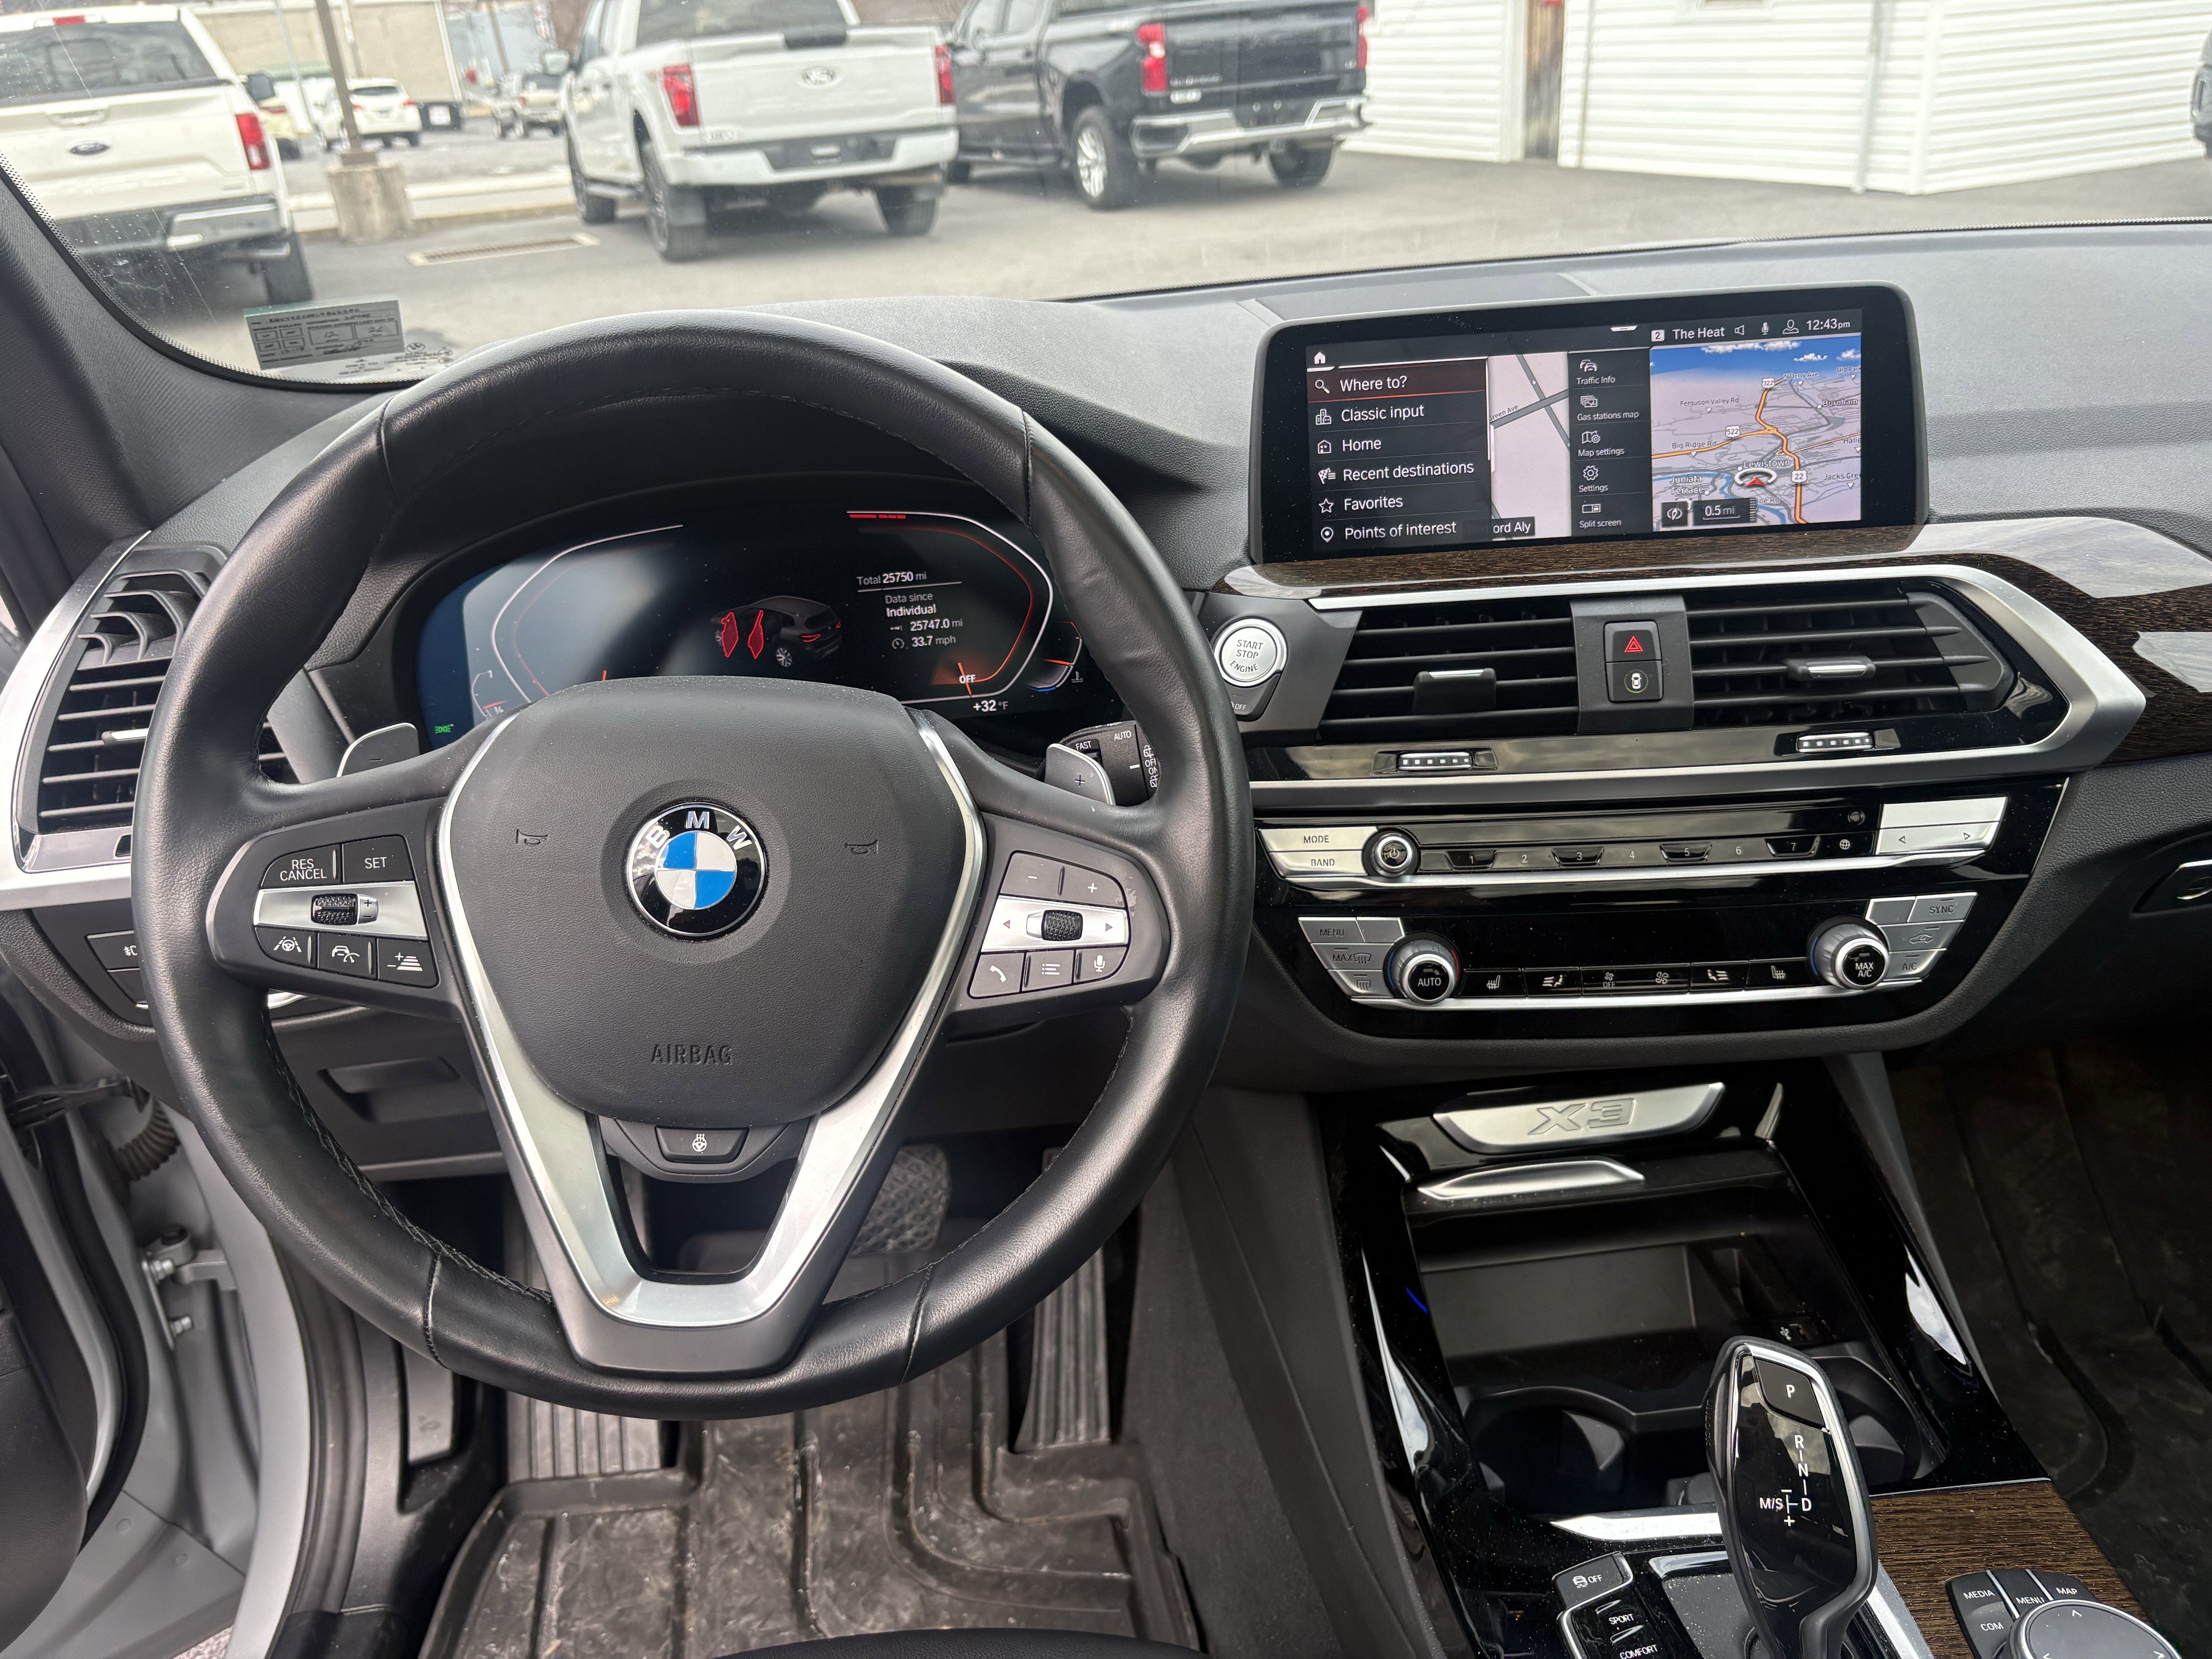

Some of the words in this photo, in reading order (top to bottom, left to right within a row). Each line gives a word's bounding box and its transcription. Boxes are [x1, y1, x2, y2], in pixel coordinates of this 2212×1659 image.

[1806, 318, 1850, 331] 12:43pm
[1673, 328, 1695, 339] The
[1698, 326, 1725, 338] Heat
[1340, 378, 1383, 392] Where
[1386, 376, 1407, 389] to?
[1507, 404, 1518, 413] Ave
[1822, 398, 1858, 407] Burnham
[1341, 407, 1387, 422] Classic
[1391, 405, 1425, 420] input
[1577, 413, 1591, 421] Gas
[1592, 412, 1621, 420] stations
[1342, 438, 1382, 452] Home
[1578, 449, 1594, 457] Map
[1595, 447, 1625, 456] settings
[1743, 459, 1790, 469] Lewistown
[1343, 467, 1389, 481] Recent
[1393, 462, 1474, 479] destinations
[1670, 475, 1702, 484] Juniata
[1578, 484, 1608, 493] Settings
[1670, 486, 1704, 495] Terrace
[1344, 496, 1403, 511] Favorites
[1705, 505, 1721, 516] 0.5
[1723, 506, 1735, 515] mi
[1514, 521, 1531, 534] Aly
[1579, 520, 1596, 528] Split
[1345, 526, 1386, 540] Points
[1389, 524, 1403, 537] of
[1406, 521, 1456, 535] interest
[857, 576, 881, 586] Total
[882, 572, 914, 584] 25750
[915, 571, 927, 581] mi
[884, 594, 907, 604] Data
[908, 592, 933, 602] since
[886, 604, 937, 617] Individual
[910, 619, 950, 631] 25747.0
[951, 618, 963, 628] mi
[911, 636, 933, 647] 33.7
[935, 635, 956, 646] mph
[1237, 639, 1264, 651] START
[1236, 649, 1259, 659] STOP
[1230, 660, 1259, 673] ENGINE
[959, 674, 976, 684] OFF
[973, 700, 998, 712] +32
[1235, 703, 1247, 711] OFF
[1114, 730, 1132, 741] AUTO
[1075, 740, 1092, 750] FAST
[645, 811, 752, 851] BMW
[1303, 834, 1329, 844] MODE
[1469, 855, 1474, 864] 1
[1521, 854, 1528, 863] 2
[1577, 852, 1583, 861] 3
[1628, 850, 1635, 859] 4
[1683, 847, 1690, 857] 5
[1735, 846, 1741, 855] 6
[1790, 842, 1796, 851] 7
[291, 858, 314, 870] RES
[364, 856, 387, 869] SET
[1310, 857, 1335, 867] BAND
[280, 868, 328, 882] CANCEL
[1929, 903, 1954, 914] SYNC
[1319, 928, 1345, 938] MENU
[1332, 953, 1353, 963] MAX
[1855, 961, 1874, 970] MAX
[1902, 960, 1917, 971] A/C
[1857, 969, 1872, 978] A/C
[1417, 977, 1441, 988] AUTO
[1602, 981, 1616, 989] OFF
[650, 1044, 733, 1066] AIRBAG
[1527, 1097, 1636, 1136] X3
[1786, 1384, 1795, 1398] P
[1795, 1434, 1805, 1449] R
[1798, 1463, 1808, 1477] N
[1759, 1497, 1784, 1510] M/S
[1802, 1498, 1812, 1511] D
[1588, 1574, 1602, 1583] OFF
[1963, 1589, 1995, 1600] MEDIA
[2056, 1587, 2078, 1596] MAP
[2016, 1596, 2045, 1605] MENU
[1608, 1613, 1635, 1625] SPORT
[1980, 1621, 2004, 1632] COM
[1620, 1644, 1658, 1659] COMFORT
